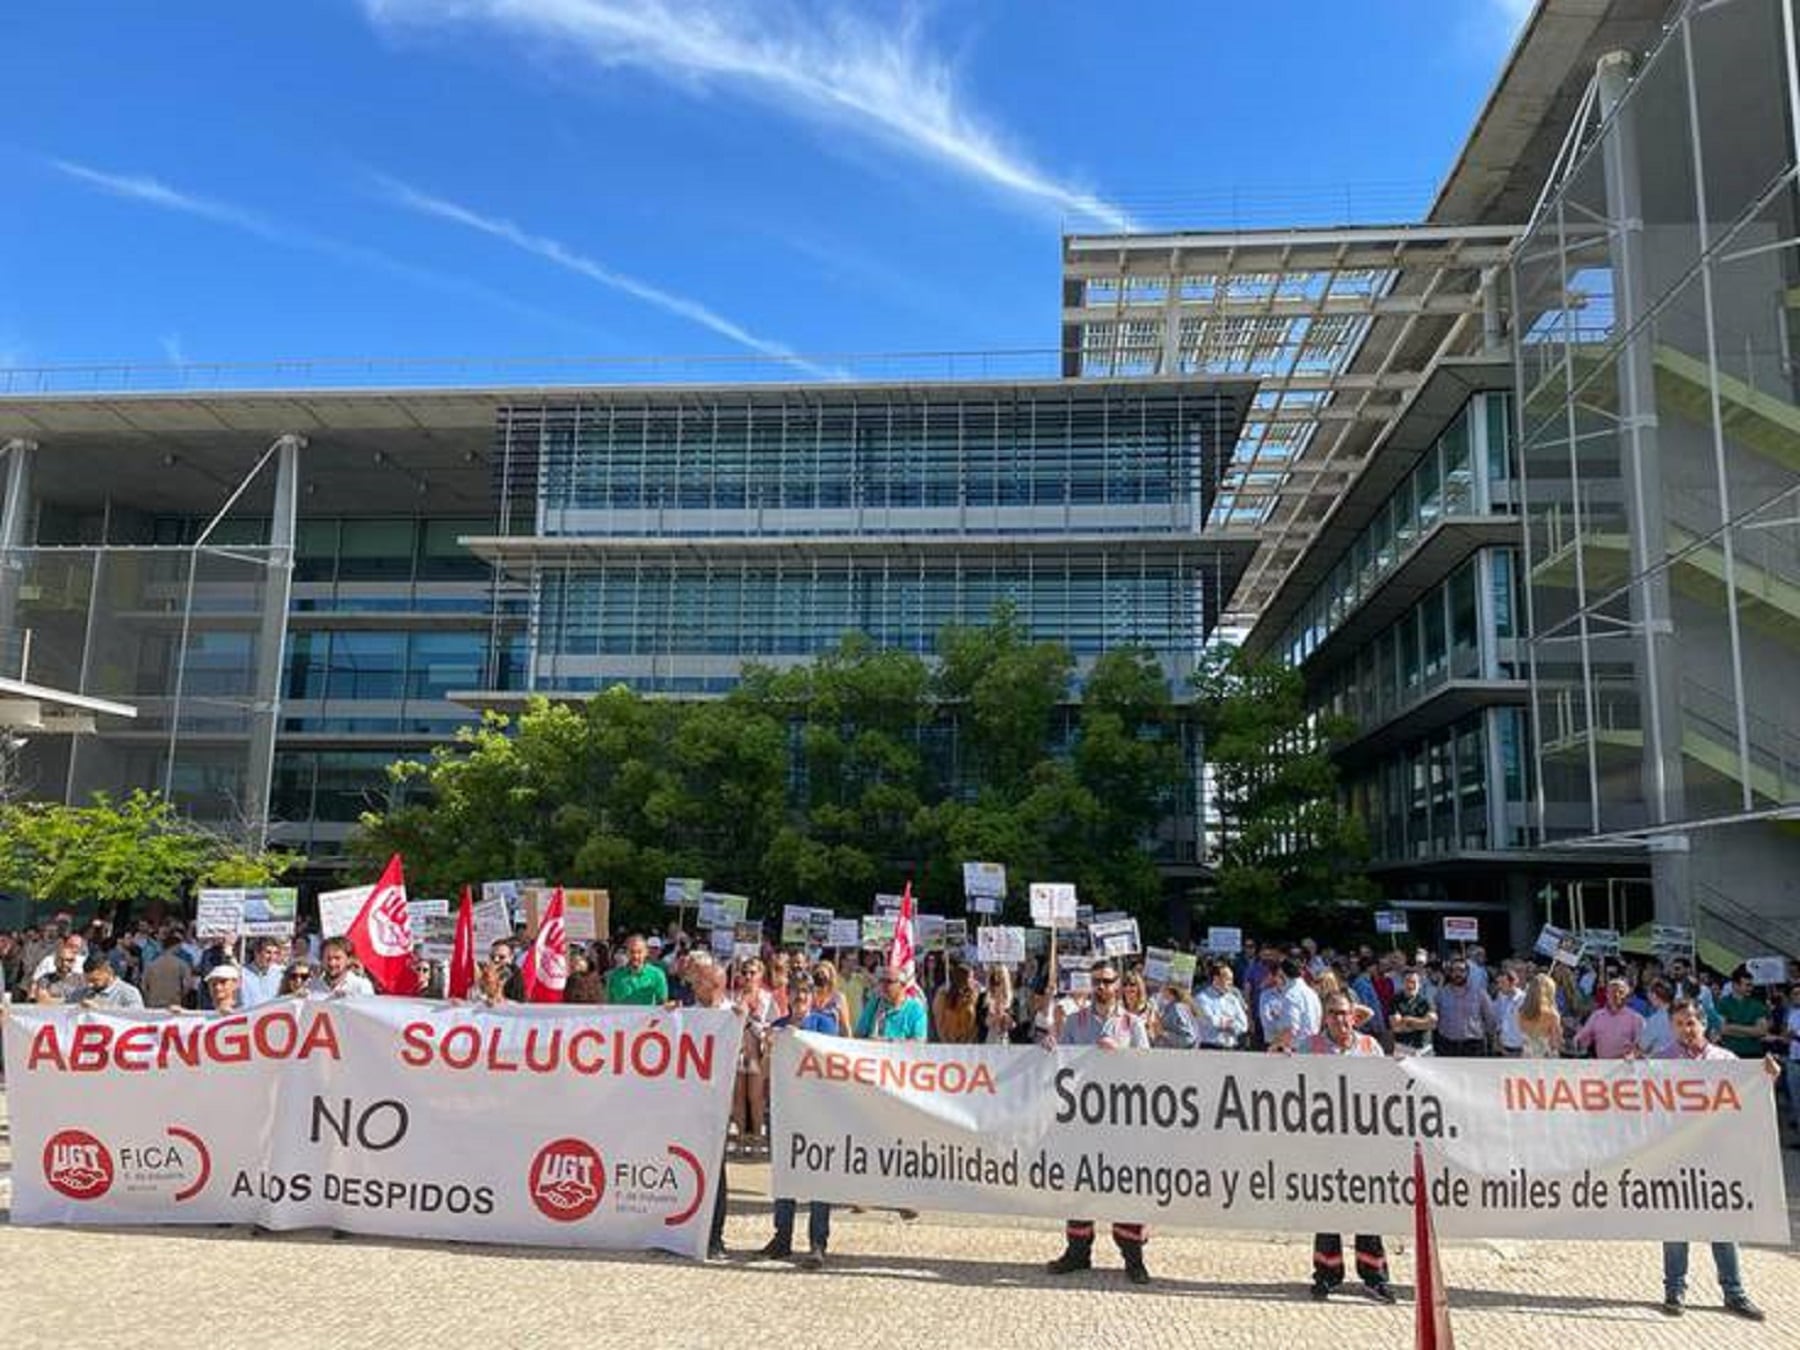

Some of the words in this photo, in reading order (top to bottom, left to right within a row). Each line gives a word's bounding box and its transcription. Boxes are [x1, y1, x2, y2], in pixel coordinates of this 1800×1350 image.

[27, 1012, 341, 1073] ABENGOA
[400, 1019, 715, 1081] SOLUCIÓN
[796, 1049, 996, 1094] ABENGOA
[1054, 1067, 1200, 1130] Somos
[1213, 1073, 1458, 1139] Andalucía.
[1504, 1077, 1742, 1112] INABENSA
[310, 1095, 410, 1151] NO
[52, 1144, 99, 1172] UGT
[119, 1146, 184, 1170] FICA
[540, 1153, 594, 1185] UGT
[614, 1163, 679, 1190] FICA
[790, 1133, 836, 1172] Por
[844, 1135, 868, 1176] la
[879, 1139, 1019, 1189] viabilidad
[1030, 1149, 1065, 1192] de
[1075, 1153, 1212, 1207] Abengoa
[1221, 1171, 1241, 1209] y
[1249, 1160, 1275, 1202] el
[1286, 1168, 1416, 1206] sustento
[1432, 1167, 1470, 1207] de
[1481, 1168, 1562, 1209] miles
[1572, 1170, 1609, 1210] de
[1618, 1168, 1754, 1212] familias.
[231, 1170, 255, 1197] A
[324, 1174, 495, 1214] DESPIDOS
